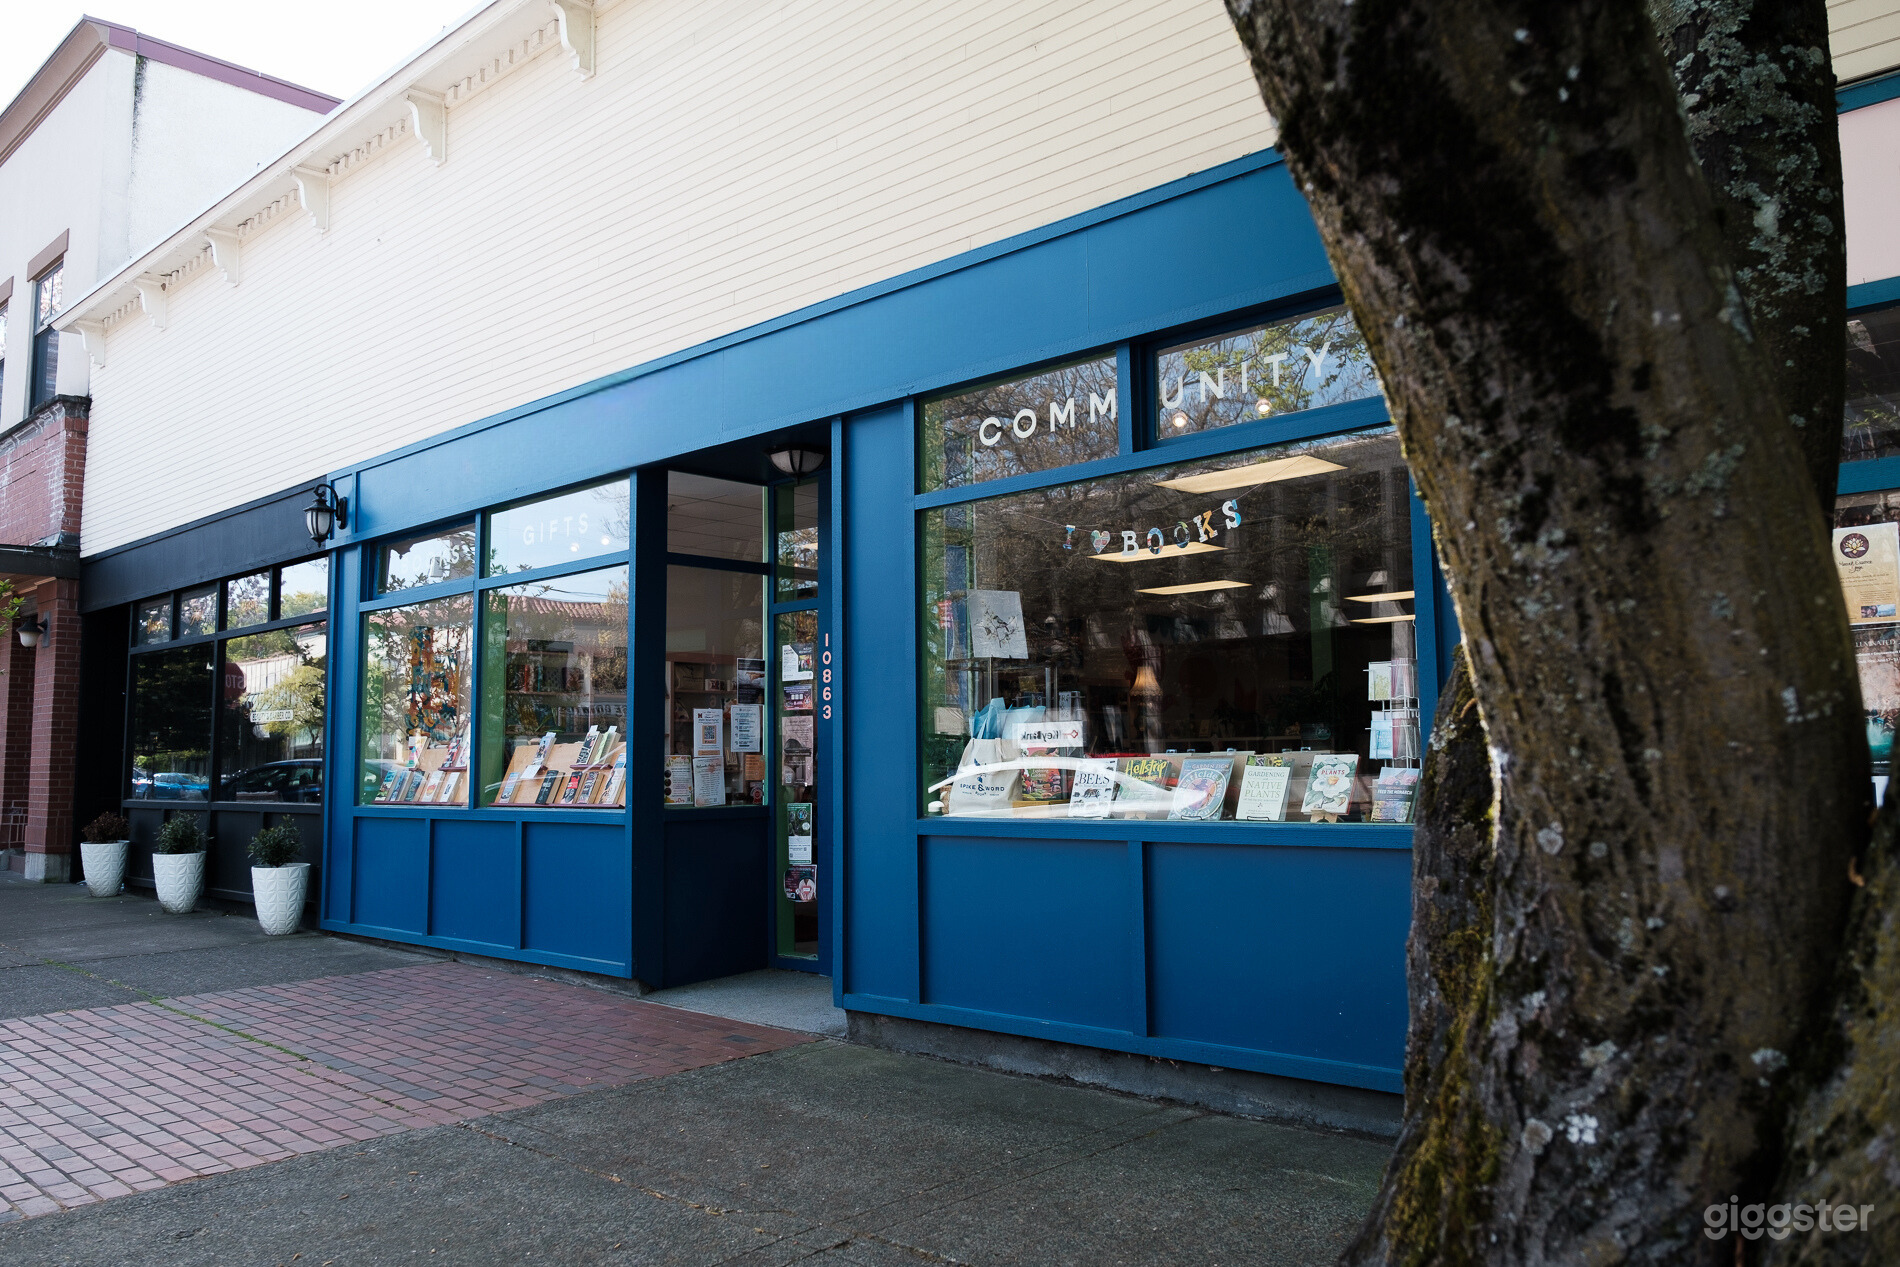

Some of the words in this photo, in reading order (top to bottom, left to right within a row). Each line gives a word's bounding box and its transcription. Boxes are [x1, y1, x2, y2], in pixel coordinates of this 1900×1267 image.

[523, 513, 588, 545] GIFTS
[1063, 525, 1075, 549] I
[1121, 499, 1241, 556] BOOKS
[400, 545, 460, 576] BOKS
[823, 633, 832, 719] 10863
[1125, 759, 1167, 778] Hellstrip
[1247, 770, 1285, 778] GARDENING
[1079, 773, 1110, 785] BEES
[1246, 781, 1283, 790] NATIVE
[1244, 790, 1281, 799] PLANTS
